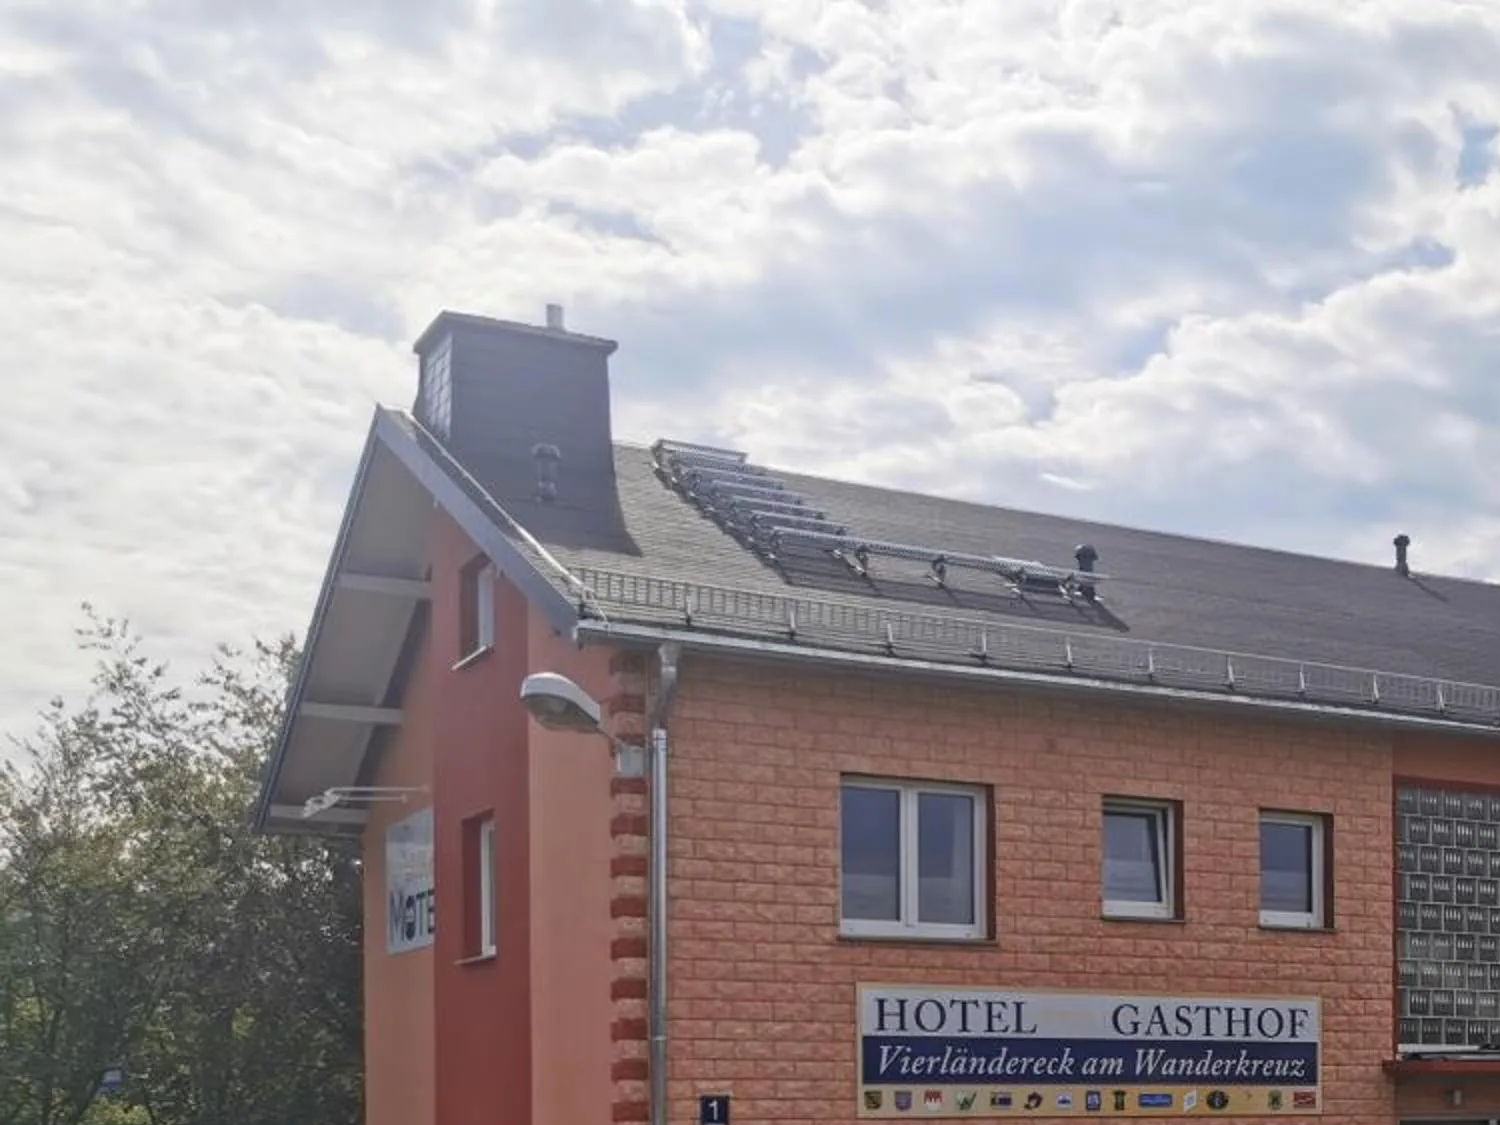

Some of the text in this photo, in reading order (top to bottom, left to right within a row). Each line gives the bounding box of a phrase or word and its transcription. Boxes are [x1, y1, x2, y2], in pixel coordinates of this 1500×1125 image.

[389, 886, 435, 943] MOTE
[874, 998, 1309, 1039] HOTEL GASTHOF
[879, 1045, 1305, 1077] Vierländereck am Wanderkreuz
[708, 1099, 718, 1121] 1
